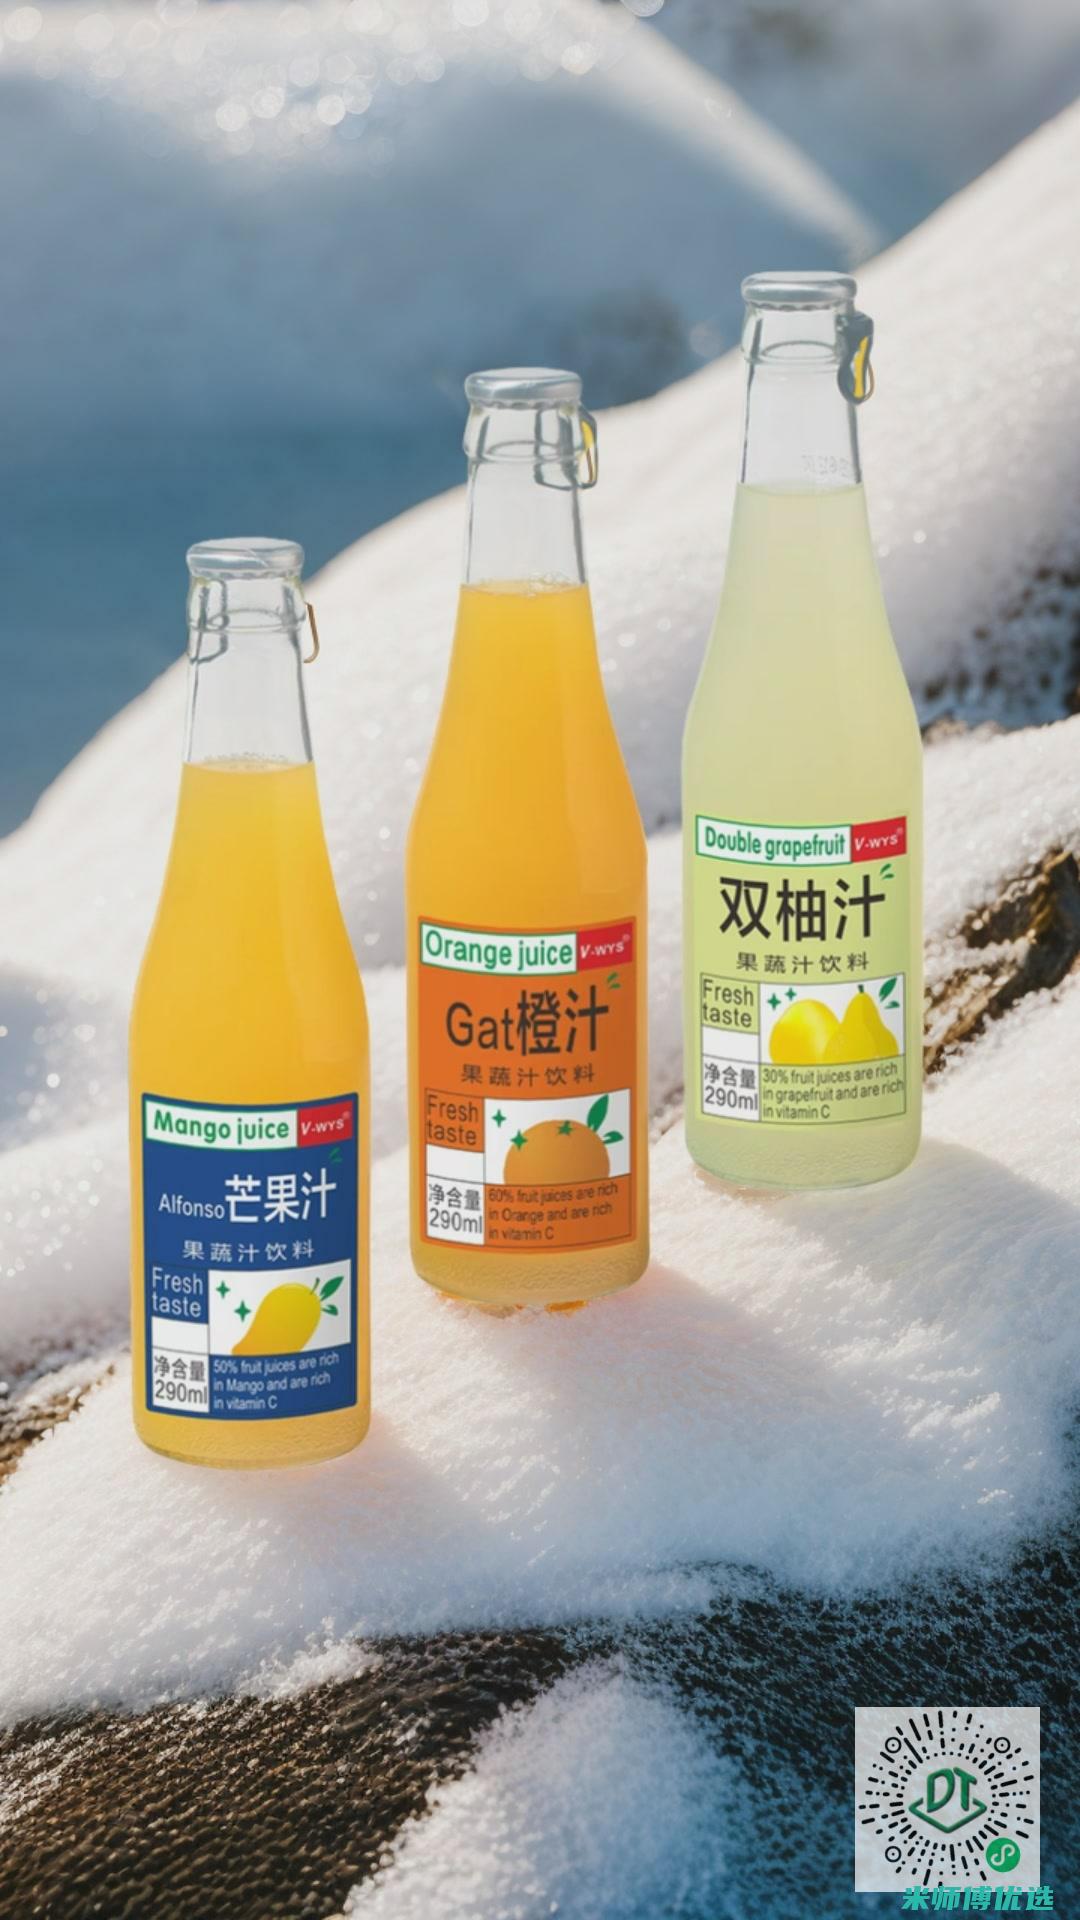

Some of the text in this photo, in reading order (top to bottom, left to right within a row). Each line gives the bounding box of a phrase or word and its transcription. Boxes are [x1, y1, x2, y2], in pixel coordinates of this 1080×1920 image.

[705, 826, 845, 861] Double grapefruit
[719, 874, 885, 942] 双柚汁
[425, 930, 573, 971] Orange juice
[736, 952, 869, 974] 果蔬汁饮料
[703, 978, 754, 1006] Fresh
[702, 1004, 752, 1028] taste
[461, 1064, 595, 1087] 果蔬汁饮料
[704, 1063, 756, 1090] 净含量
[763, 1064, 898, 1087] 30% fruit juices are rich
[705, 1086, 758, 1110] 290ml
[763, 1079, 904, 1104] in grapefruit and are rich
[427, 1095, 478, 1123] Fresh
[763, 1104, 830, 1119] in vitamin C
[154, 1109, 289, 1144] Mango juice
[427, 1121, 477, 1145] taste
[428, 1184, 480, 1211] 净含量
[517, 1189, 539, 1203] fruit
[576, 1188, 595, 1200] are
[597, 1182, 618, 1195] rich
[429, 1208, 482, 1233] 290ml
[489, 1202, 613, 1225] in Orange and are rich
[489, 1227, 554, 1240] in vitamin C
[182, 1239, 314, 1263] 果蔬汁饮料
[152, 1267, 203, 1295] Fresh
[152, 1291, 201, 1318] taste
[154, 1355, 205, 1382] 净含量
[213, 1351, 339, 1376] 50% fruit juices are rich
[155, 1380, 207, 1404] 290ml
[213, 1372, 331, 1394] in Mango and are rich
[213, 1396, 278, 1410] in vitamin C
